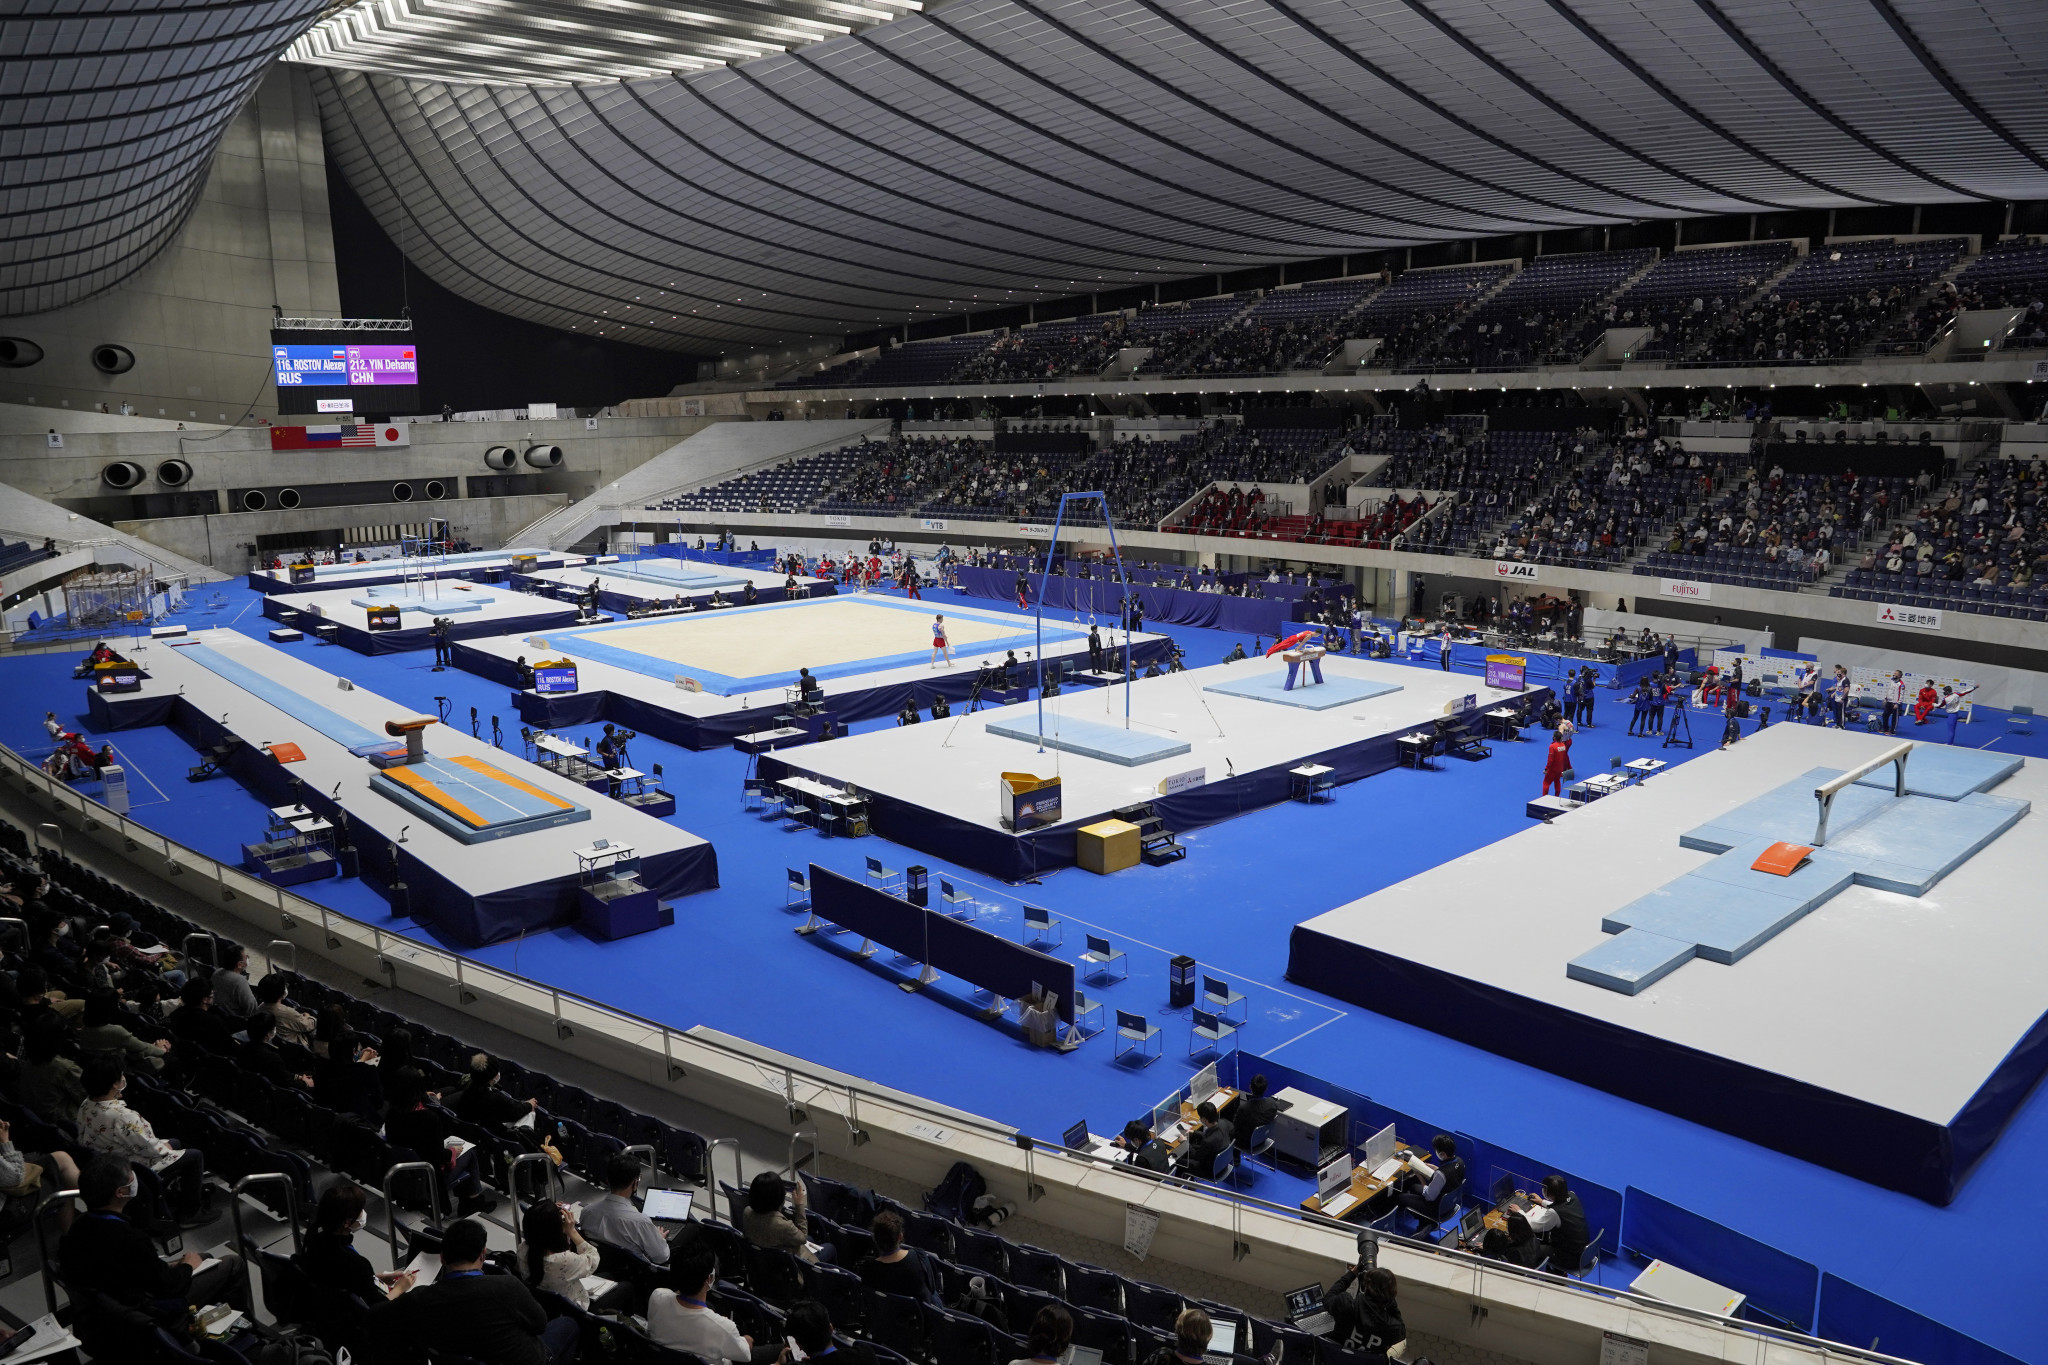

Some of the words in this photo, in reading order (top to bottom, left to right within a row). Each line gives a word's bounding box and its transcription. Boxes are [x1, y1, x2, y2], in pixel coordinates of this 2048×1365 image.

[277, 360, 292, 370] 116.
[294, 360, 321, 370] ROSTOV
[323, 360, 346, 372] Alexey
[350, 360, 368, 370] 212.
[370, 360, 384, 370] YIN
[385, 360, 415, 372] Dehang
[278, 373, 302, 384] RUS
[351, 372, 374, 383] CHN
[930, 521, 944, 529] VTB
[1510, 565, 1536, 576] JAL
[1672, 584, 1699, 596] FUJITSU
[1898, 612, 1937, 625] 三菱地所
